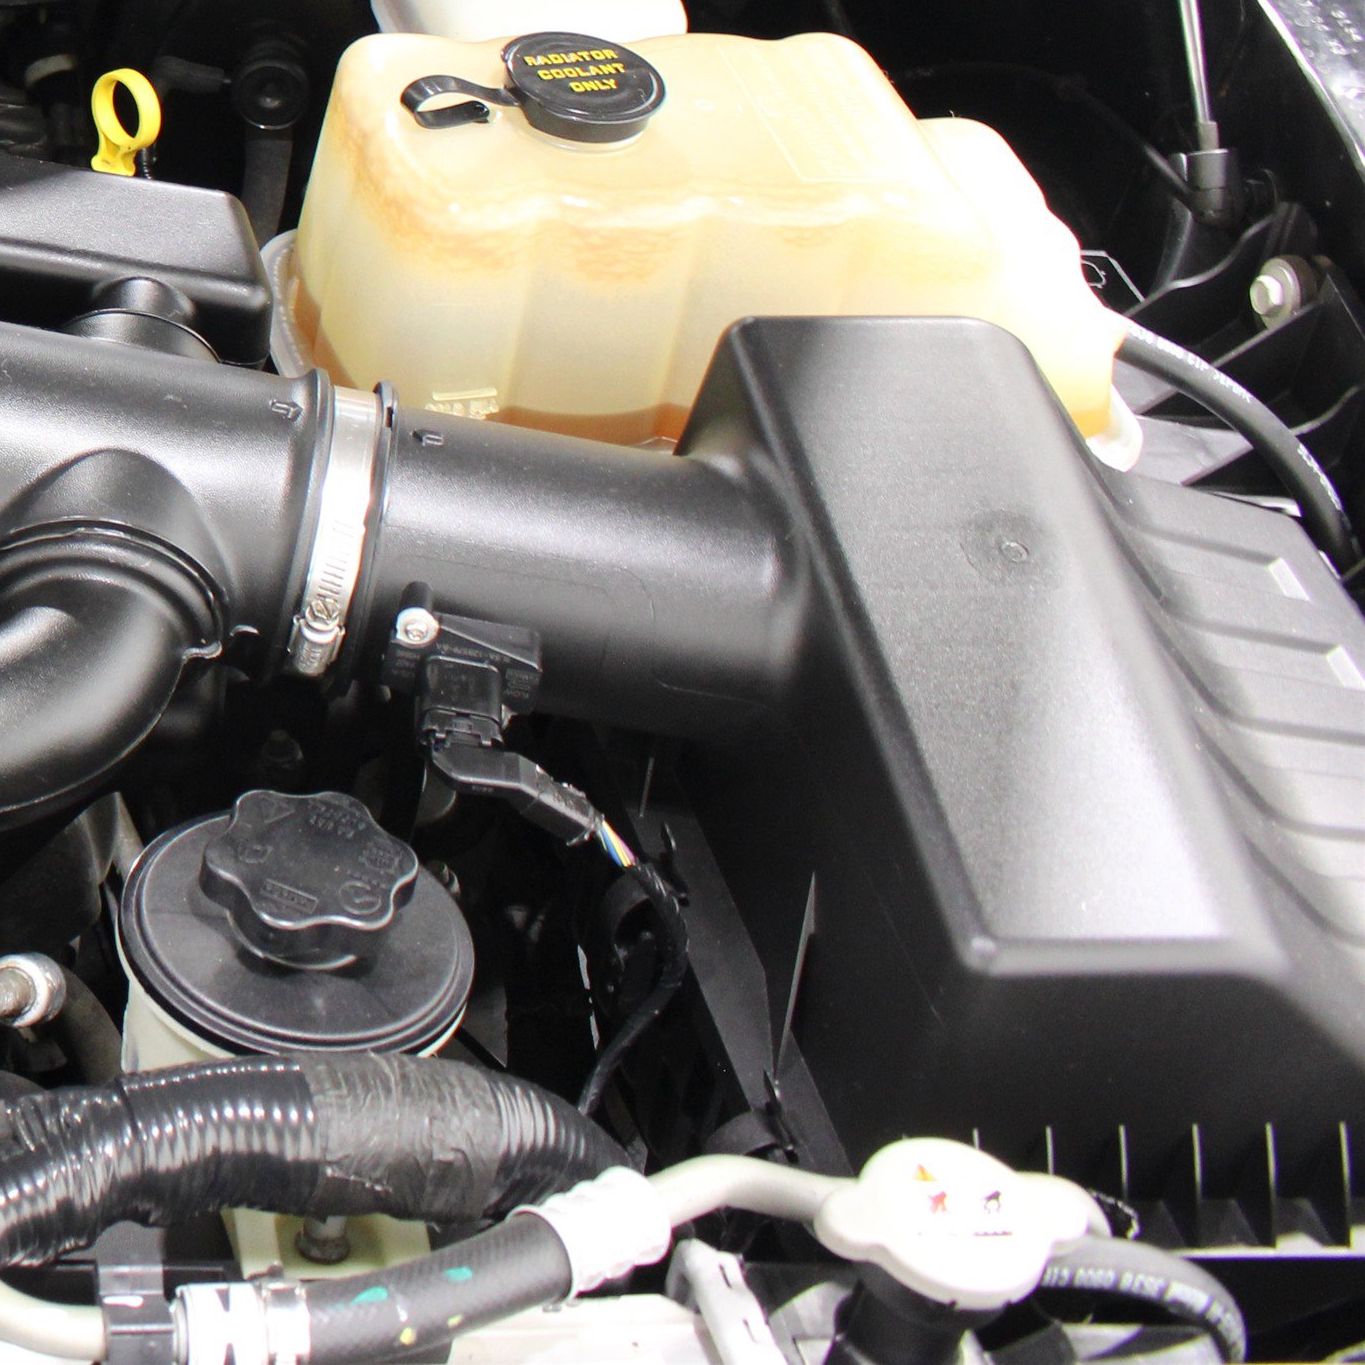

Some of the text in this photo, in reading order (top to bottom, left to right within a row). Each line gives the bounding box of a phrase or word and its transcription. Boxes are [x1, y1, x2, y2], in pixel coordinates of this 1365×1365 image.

[523, 49, 619, 66] RADIATOR
[537, 62, 627, 80] COOLANT
[569, 78, 618, 93] ONLY
